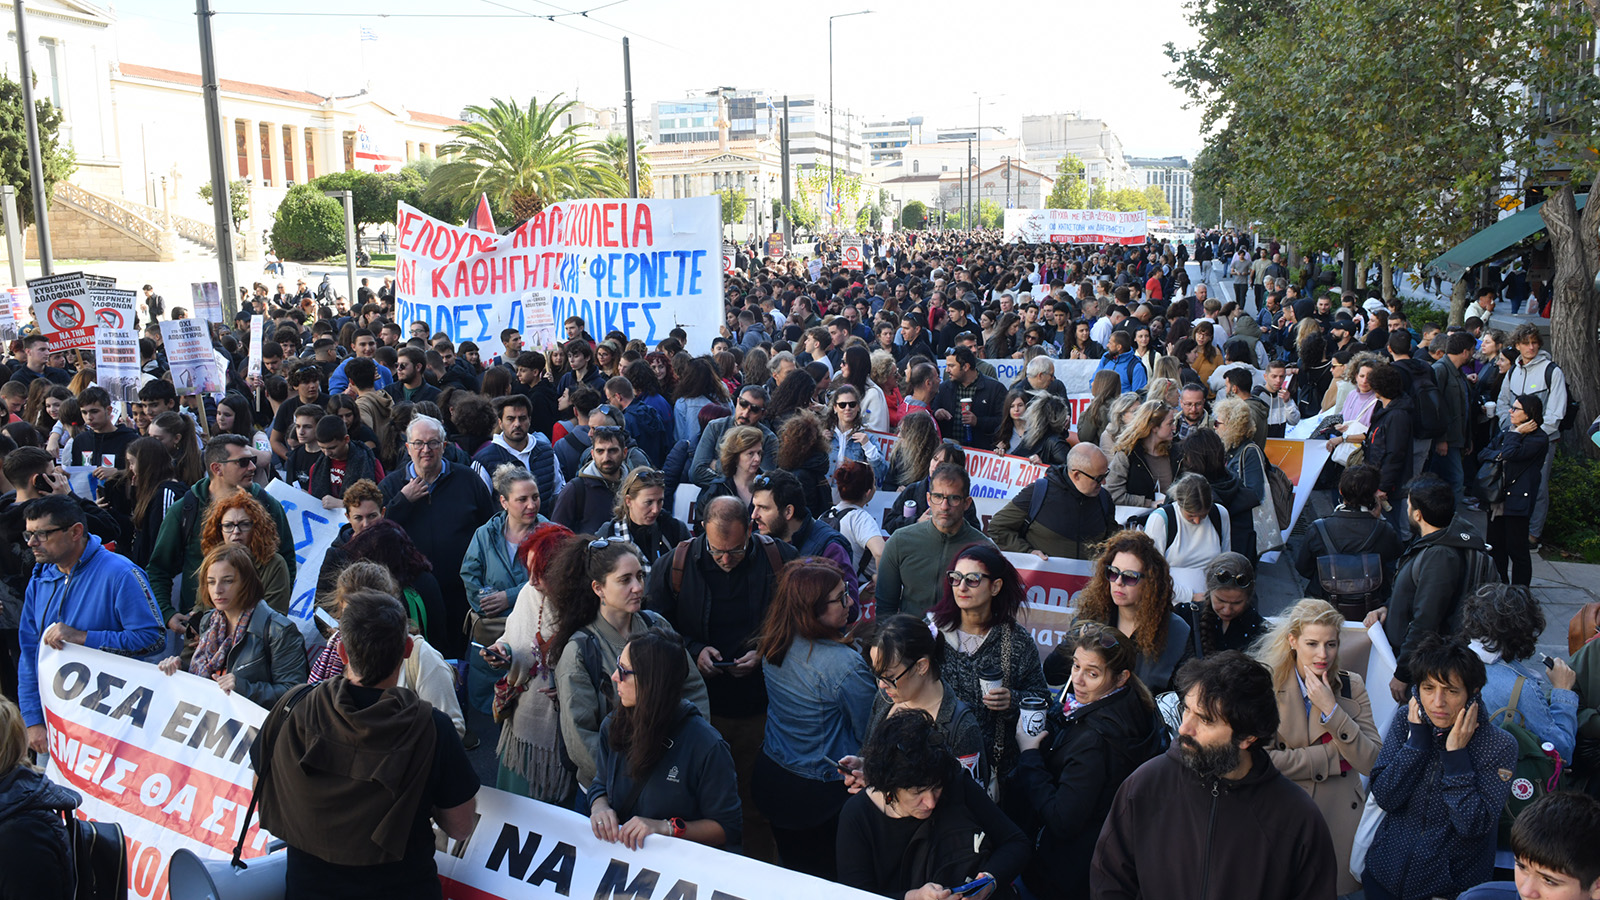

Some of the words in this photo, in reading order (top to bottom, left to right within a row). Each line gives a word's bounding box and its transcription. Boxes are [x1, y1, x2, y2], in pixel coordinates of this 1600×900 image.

[33, 280, 82, 296] ΚΥΒΕΡΝΗΣΗ
[589, 249, 707, 298] ΦΕΡΝΕΤΕ
[34, 288, 86, 304] ΔΟΛΟΦΟΝΩΝ
[58, 331, 71, 340] ΝΑ
[71, 328, 86, 339] ΤΗΝ
[178, 320, 192, 328] ΟΧΙ
[52, 661, 155, 729] ΟΣΑ
[48, 721, 139, 795] ΕΜΕΙΣ
[139, 772, 199, 822] ΘΑ
[484, 822, 578, 898] ΝΑ
